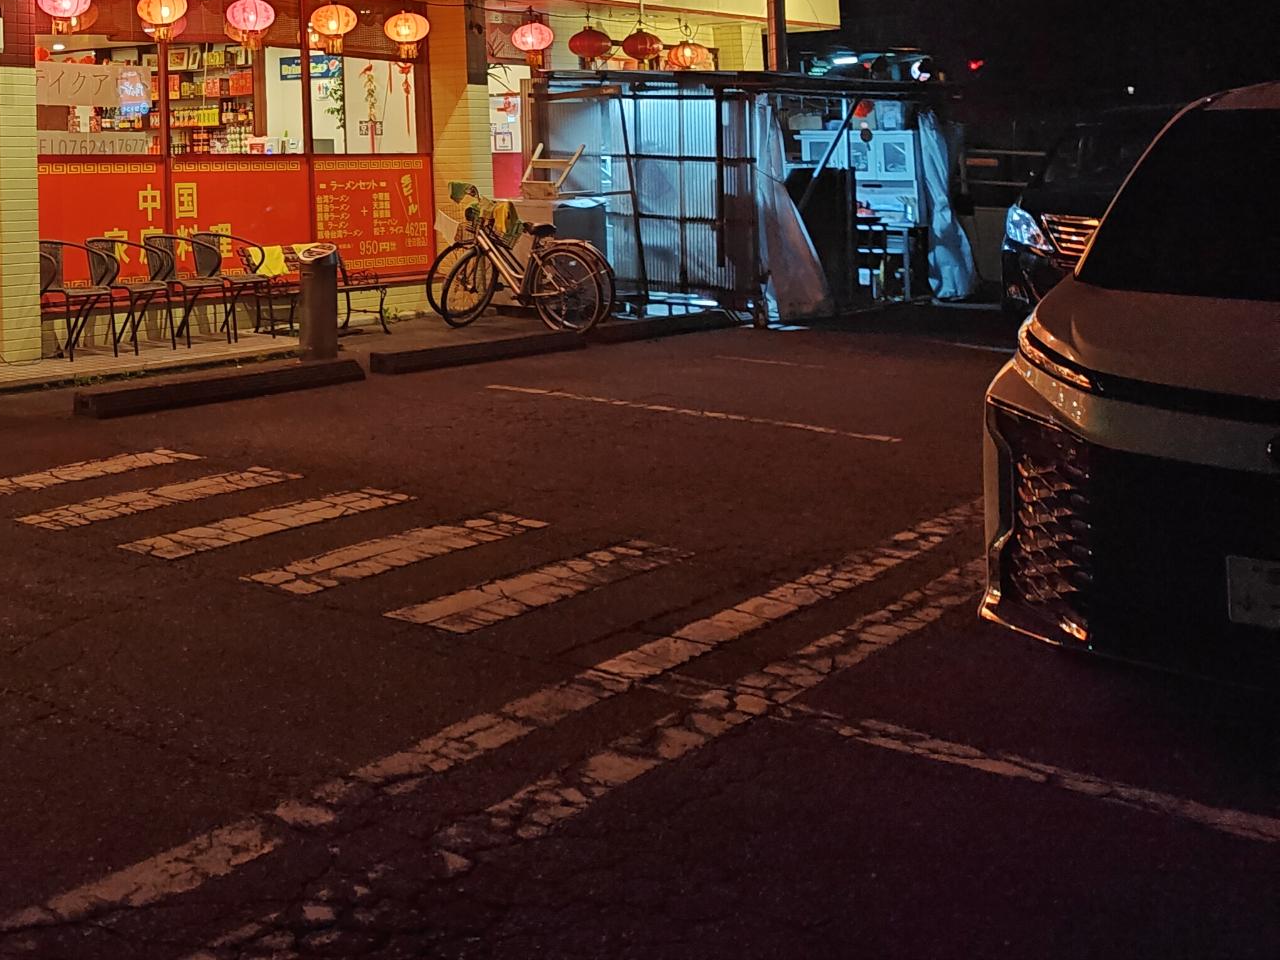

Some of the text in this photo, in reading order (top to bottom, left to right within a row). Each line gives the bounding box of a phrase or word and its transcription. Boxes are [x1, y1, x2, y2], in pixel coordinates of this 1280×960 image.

[330, 179, 378, 191] ラーメンセット
[138, 183, 197, 221] 中国
[405, 222, 428, 236] 462円
